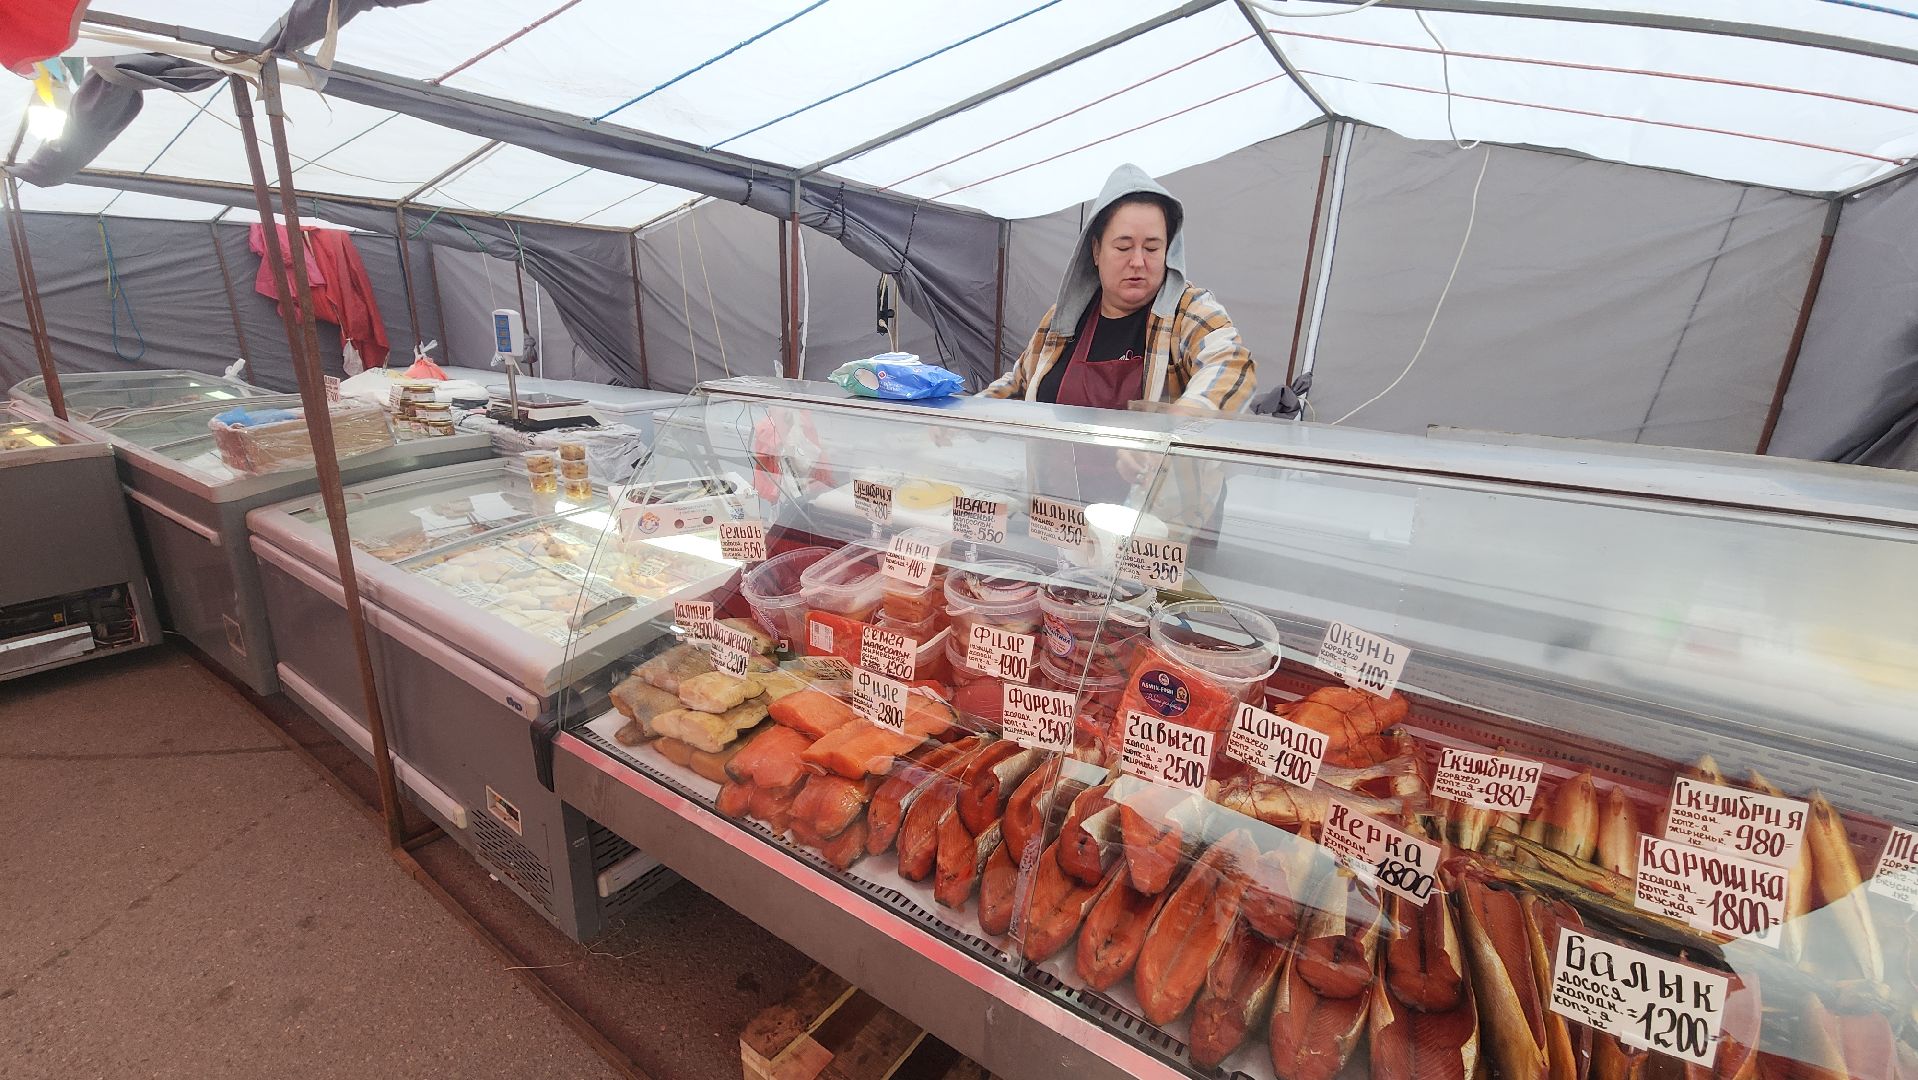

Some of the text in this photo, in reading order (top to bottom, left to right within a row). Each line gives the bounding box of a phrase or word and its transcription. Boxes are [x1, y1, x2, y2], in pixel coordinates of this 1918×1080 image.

[956, 496, 997, 515] ИВАСИ
[1032, 496, 1086, 526] Килька
[720, 524, 762, 538] Сельдь
[895, 538, 930, 560] Икра
[974, 626, 1025, 654] Филе
[1330, 622, 1395, 666] Окунь
[858, 672, 898, 704] Филе
[1008, 688, 1072, 718] Форель
[1128, 714, 1208, 756] Чавыча
[1238, 706, 1322, 760] Дорадо
[1440, 750, 1539, 784] Скумбрия
[1672, 808, 1720, 824] холодн.
[1676, 781, 1804, 831] Скумбрия
[1328, 804, 1422, 868] Нерка
[1638, 872, 1696, 894] холодн.
[1642, 838, 1785, 902] Корюшка
[1638, 882, 1688, 903] копч-я
[1557, 970, 1626, 1002] лосося
[1566, 935, 1718, 1012] Балык
[1553, 994, 1613, 1023] копч-я
[1556, 984, 1624, 1015] холодн.
[1588, 1016, 1608, 1030] 1кг
